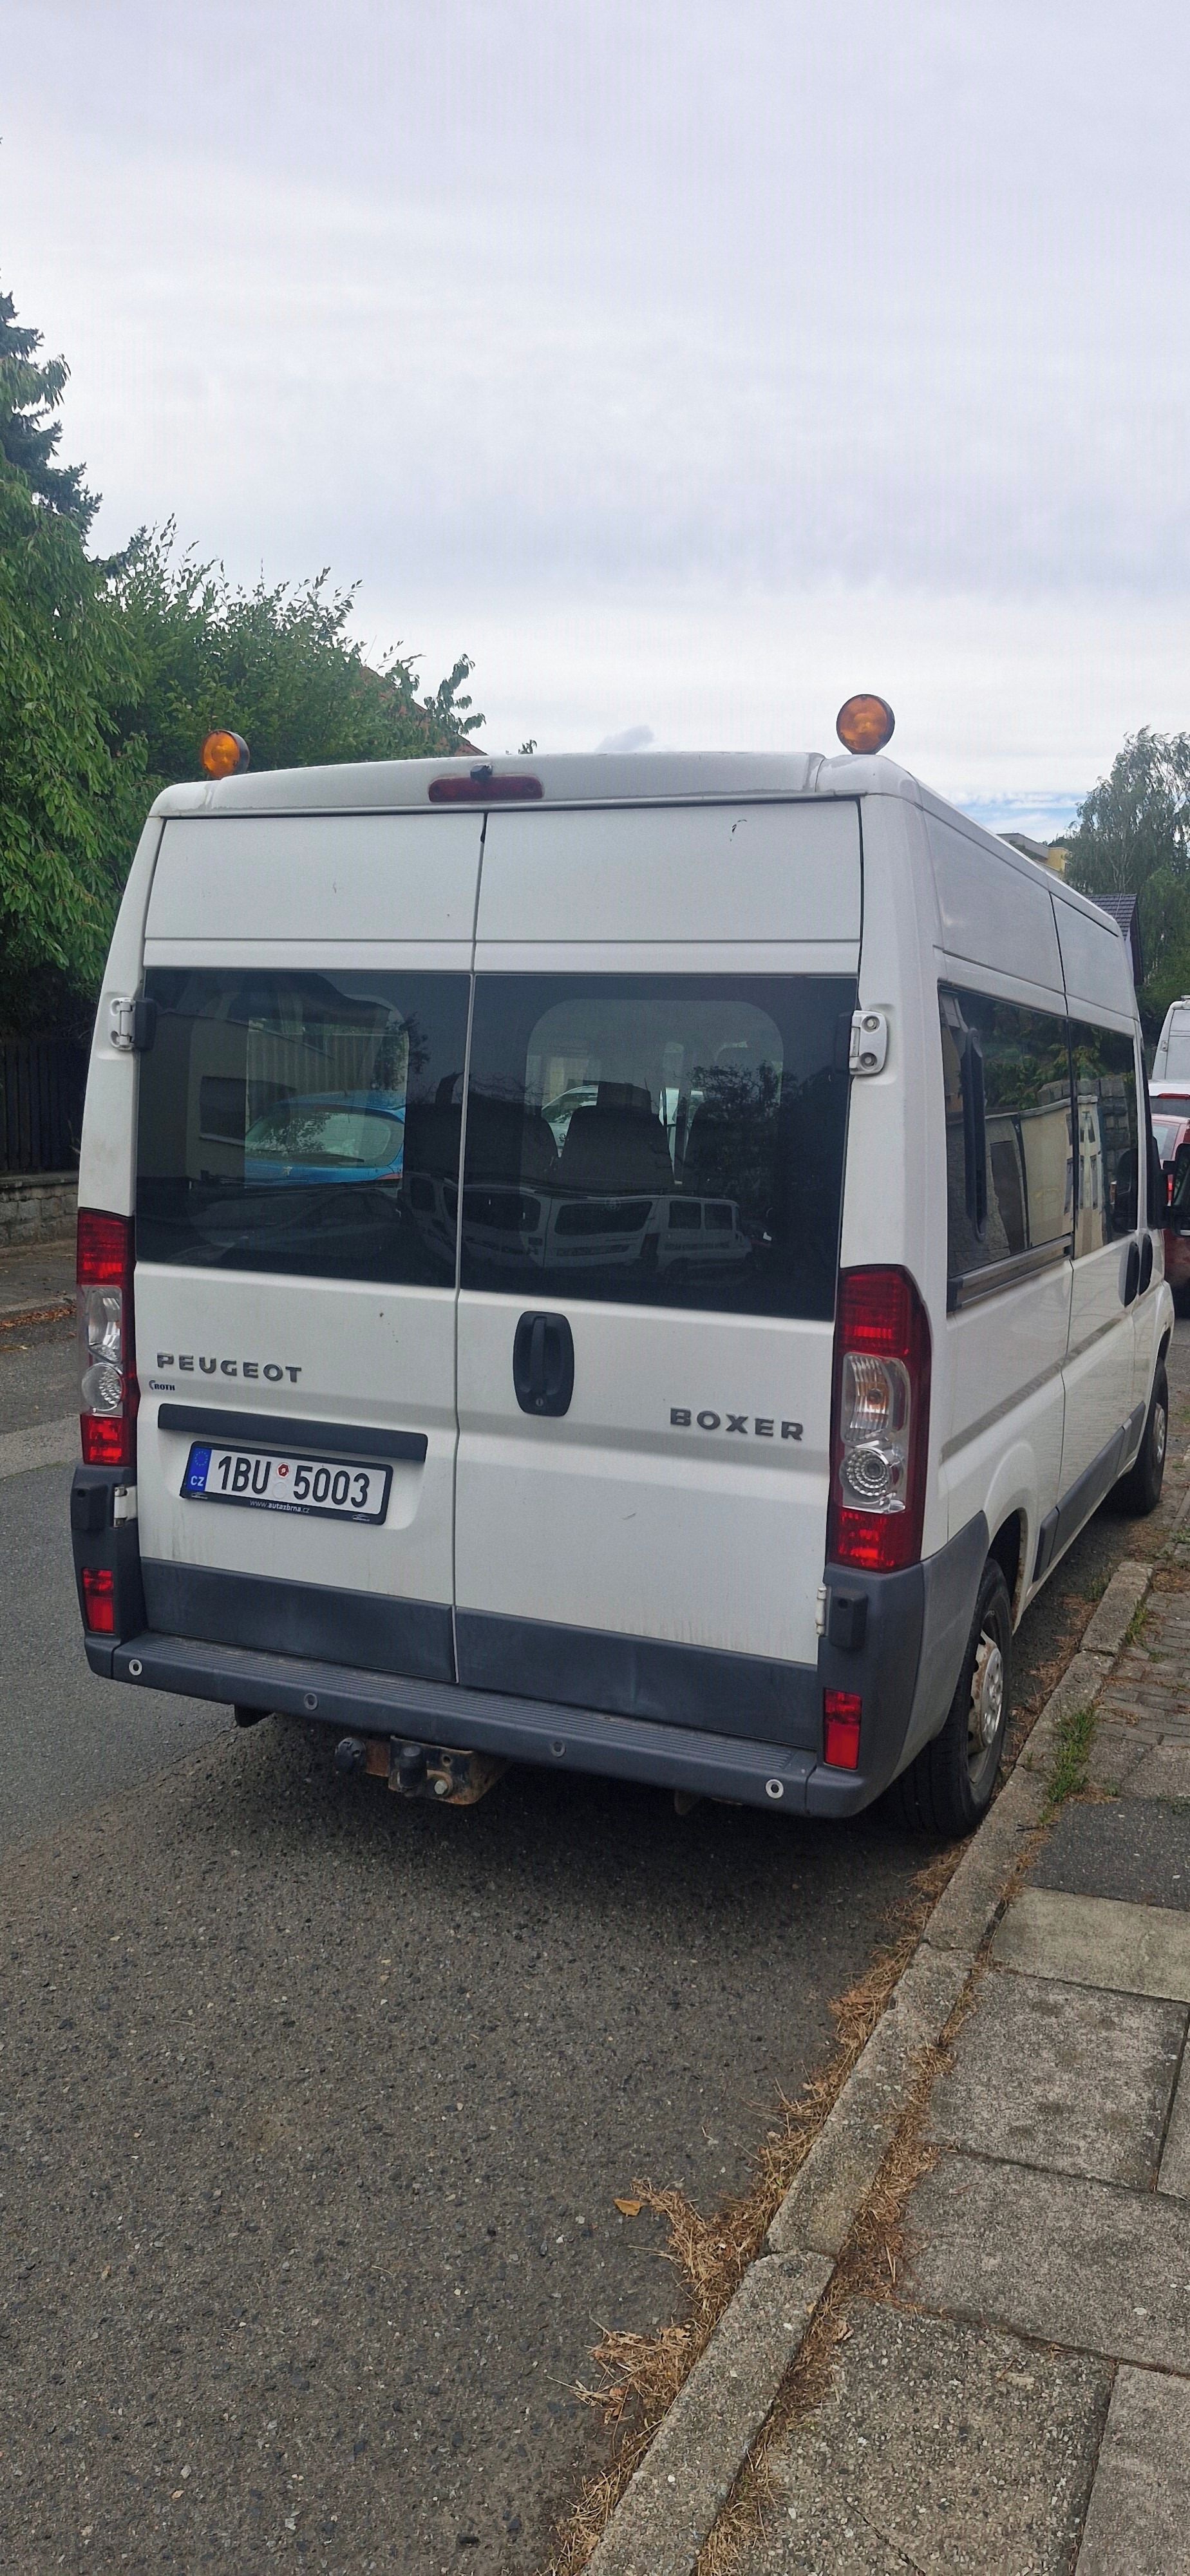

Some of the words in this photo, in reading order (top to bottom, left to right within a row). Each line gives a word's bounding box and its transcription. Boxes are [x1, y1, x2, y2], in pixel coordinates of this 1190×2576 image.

[156, 1352, 302, 1383] PEUGEOT
[670, 1407, 804, 1441] BOXER
[191, 1475, 205, 1486] CZ
[218, 1455, 271, 1494] 1BU
[293, 1465, 370, 1508] 5003
[250, 1499, 310, 1513] www.autazbrna.cz
